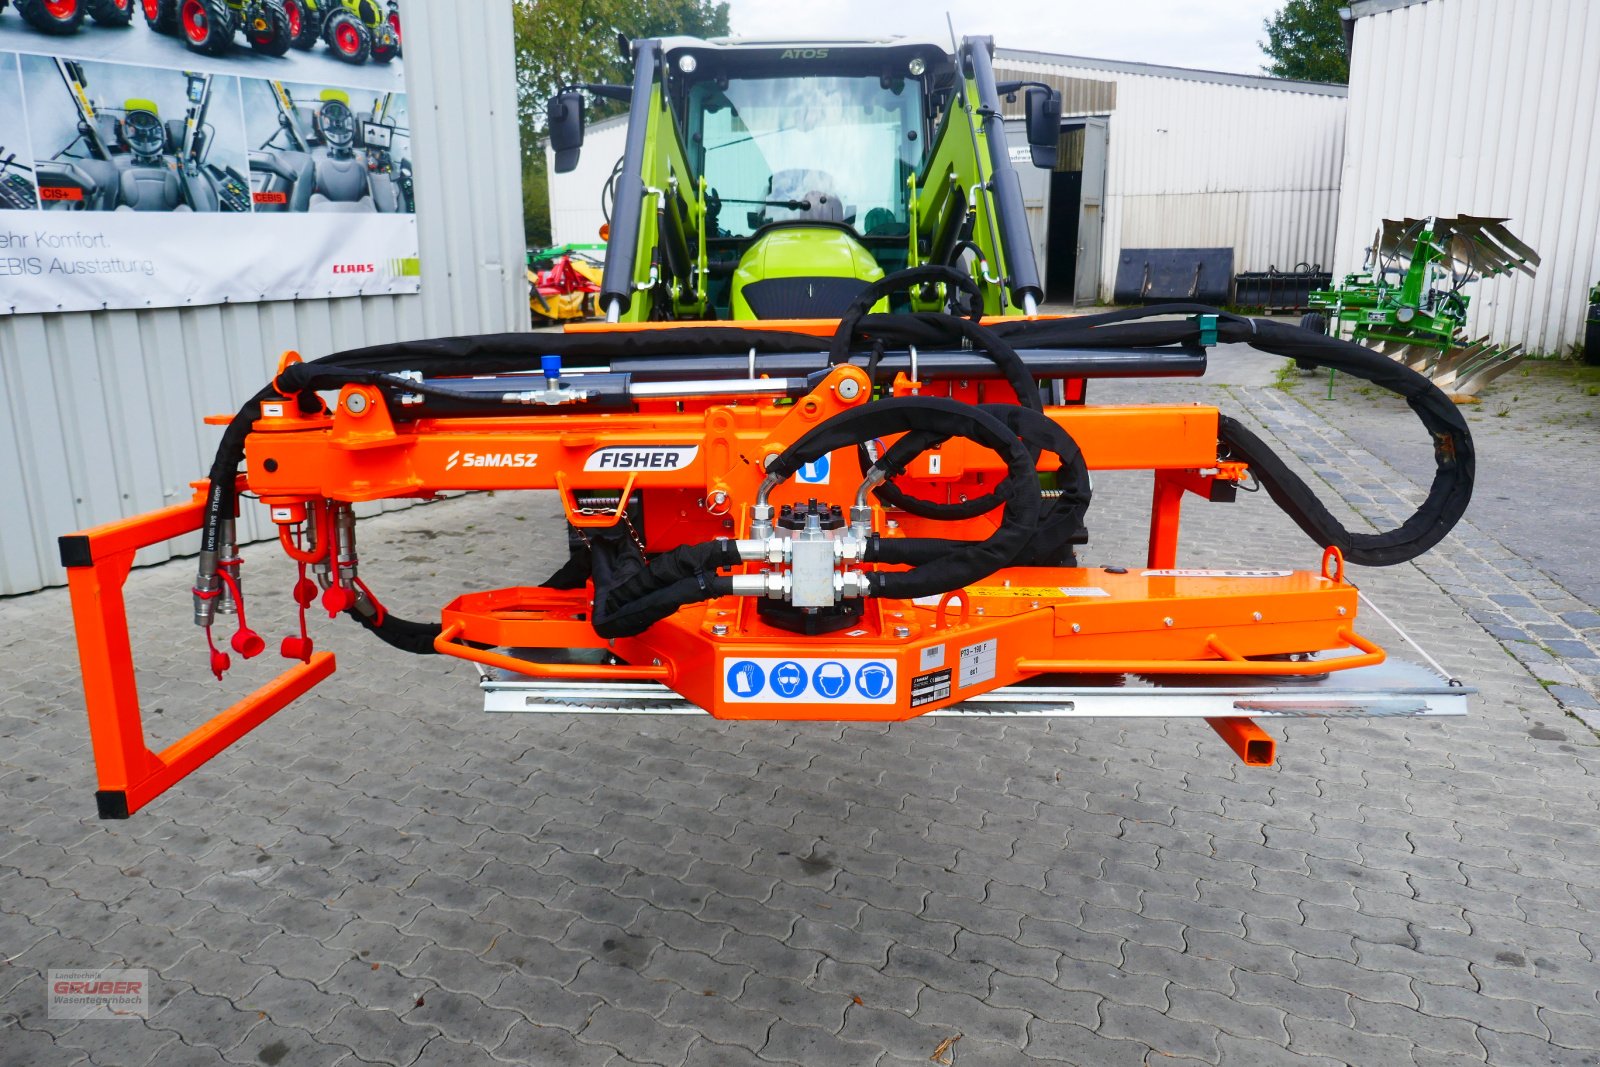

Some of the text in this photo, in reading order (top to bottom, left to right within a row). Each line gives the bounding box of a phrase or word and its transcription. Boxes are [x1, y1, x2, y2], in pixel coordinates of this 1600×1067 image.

[781, 48, 829, 59] ATOS
[42, 188, 69, 198] CIS+
[255, 194, 282, 202] CEBIS
[35, 231, 111, 249] Komfort.
[49, 256, 159, 276] Ausstattung.
[332, 264, 374, 274] CLAAS
[462, 453, 538, 468] SaMASZ
[600, 452, 680, 468] FISHER
